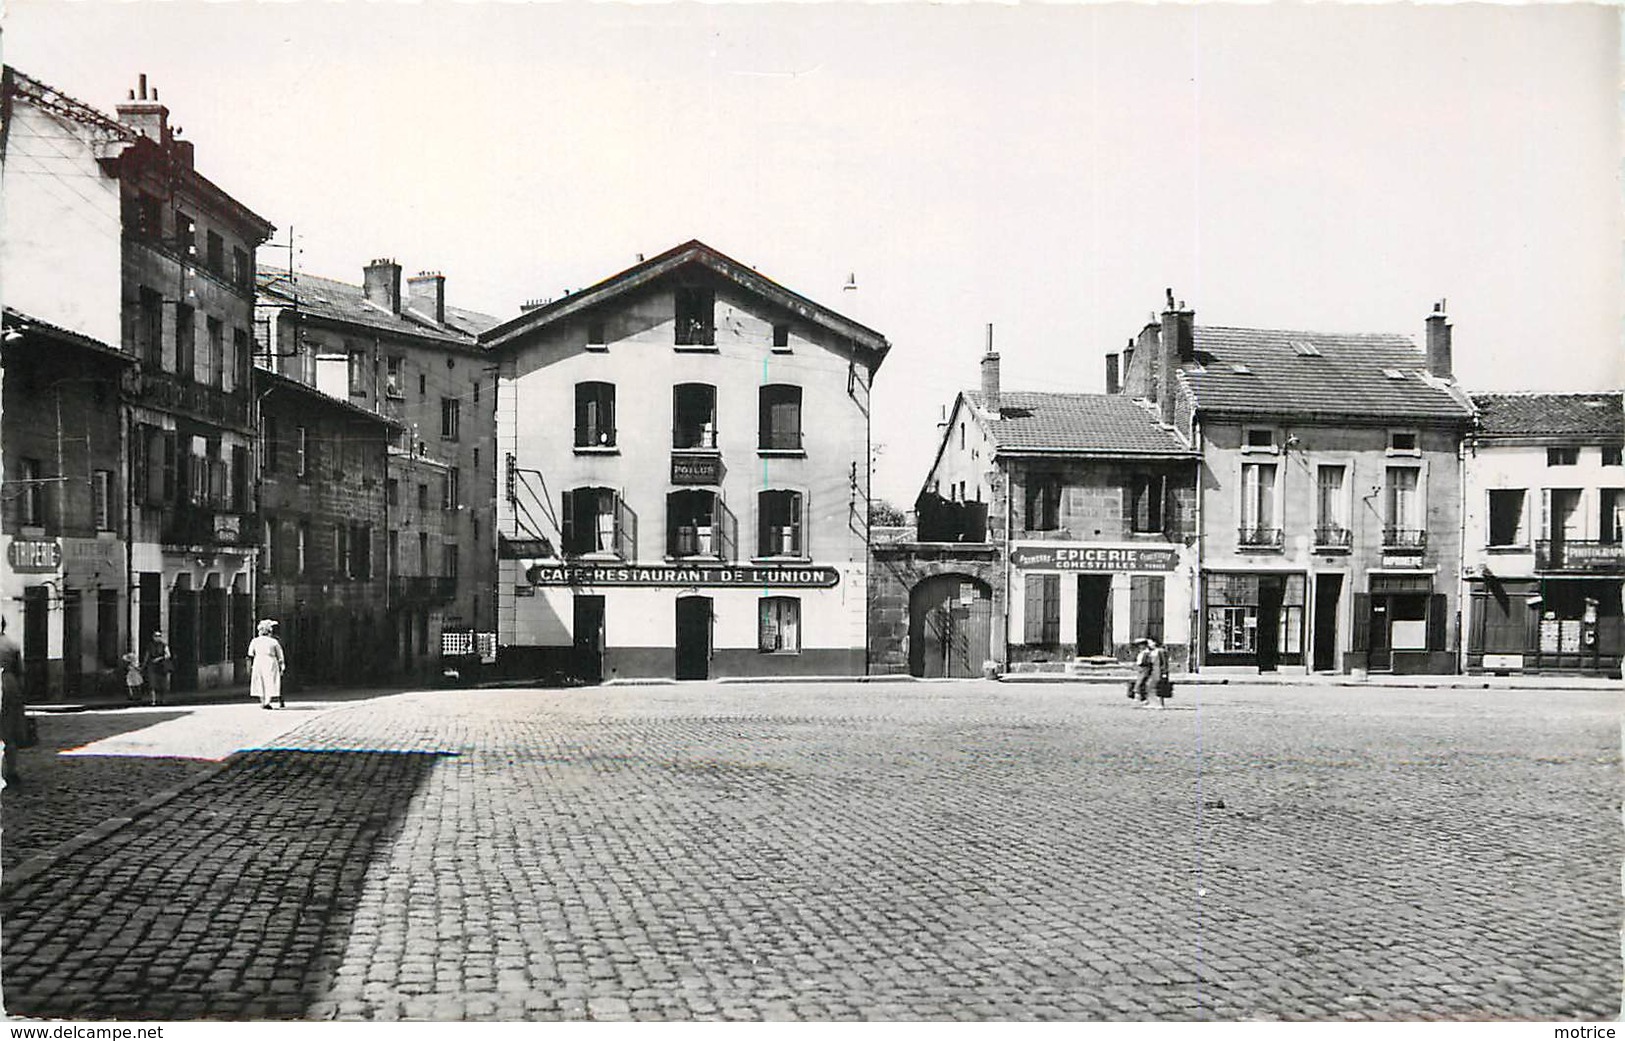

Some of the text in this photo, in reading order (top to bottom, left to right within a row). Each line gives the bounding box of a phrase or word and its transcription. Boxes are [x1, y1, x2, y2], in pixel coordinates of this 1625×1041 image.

[14, 541, 57, 567] TRIPERIE
[1056, 549, 1137, 561] EPICERIE
[1056, 561, 1136, 569] COMESTIBLES
[720, 570, 743, 581] DE
[753, 570, 825, 582] L'UNION
